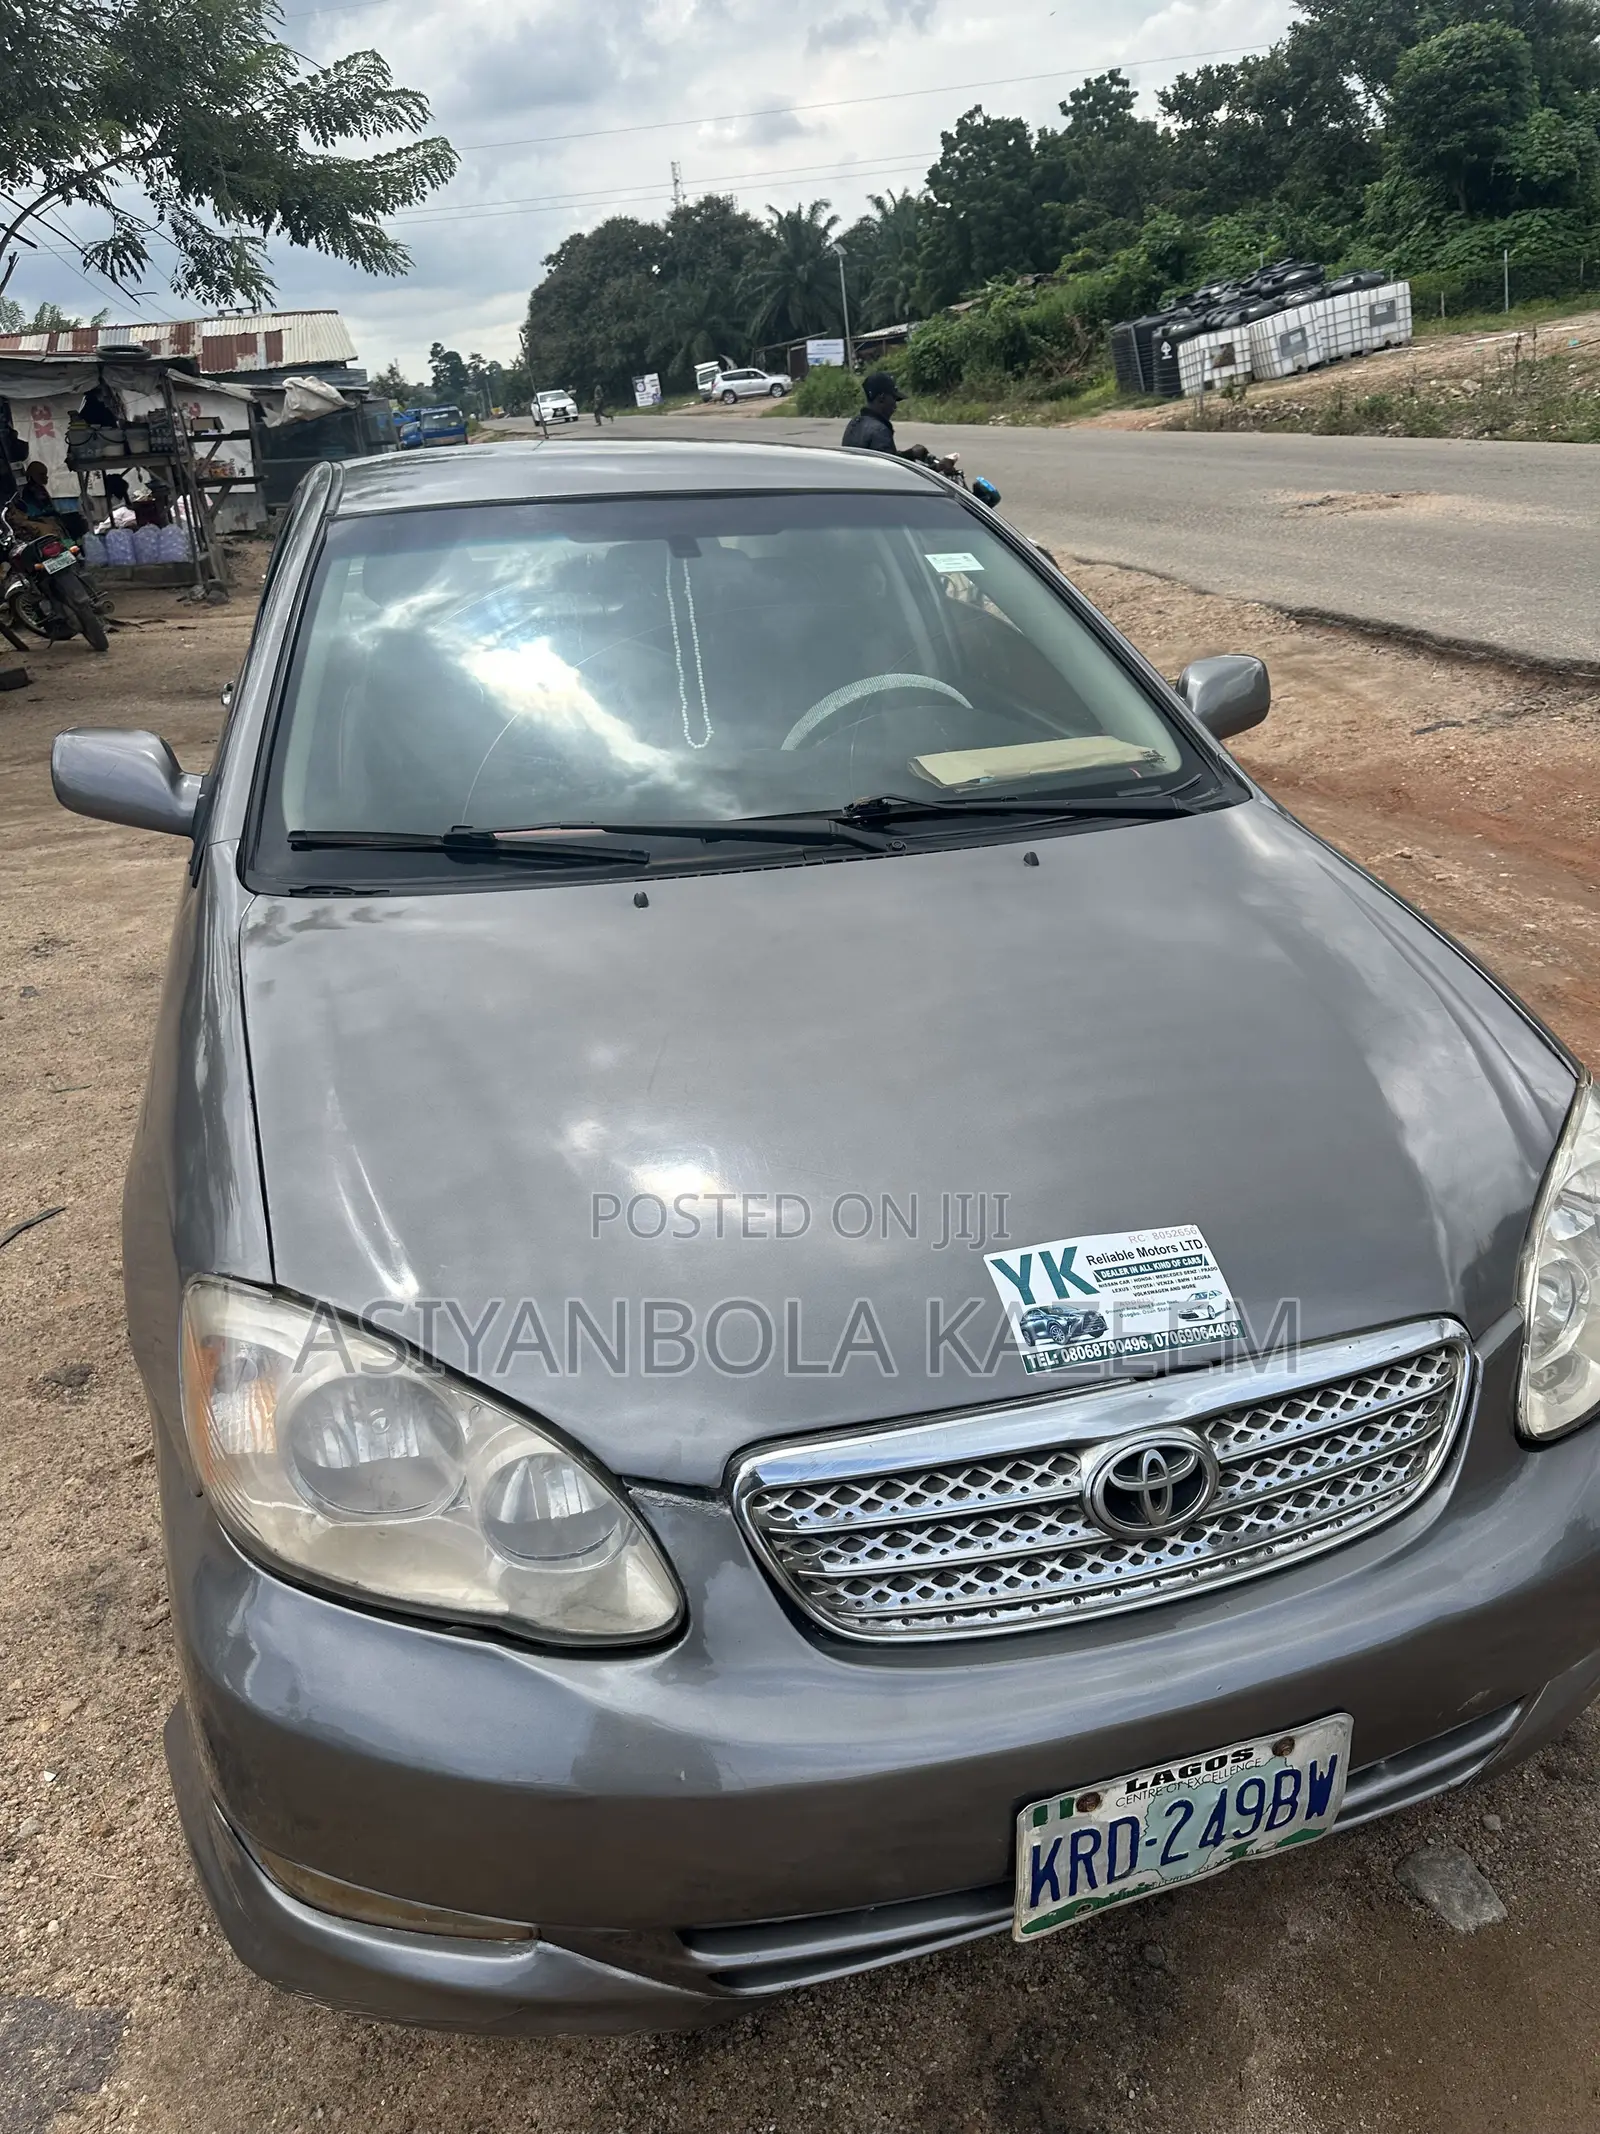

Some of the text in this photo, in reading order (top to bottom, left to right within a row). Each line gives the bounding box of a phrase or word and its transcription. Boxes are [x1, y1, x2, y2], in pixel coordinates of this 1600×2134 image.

[1086, 1239, 1207, 1266] Reliable Motors LTD.
[1101, 1256, 1202, 1278] DEALER IN ALL KIND OF CARS
[990, 1246, 1101, 1306] YK
[1112, 1286, 1130, 1294] LEXUS
[1156, 1272, 1183, 1280] MERCEDES
[1027, 1322, 1239, 1368] TEL: 08068790496, 07069064496
[1116, 1758, 1262, 1808] CENTRE OF EXCELLENCE
[1125, 1747, 1254, 1795] LAGOS
[1030, 1754, 1338, 1908] KRD-249BW
